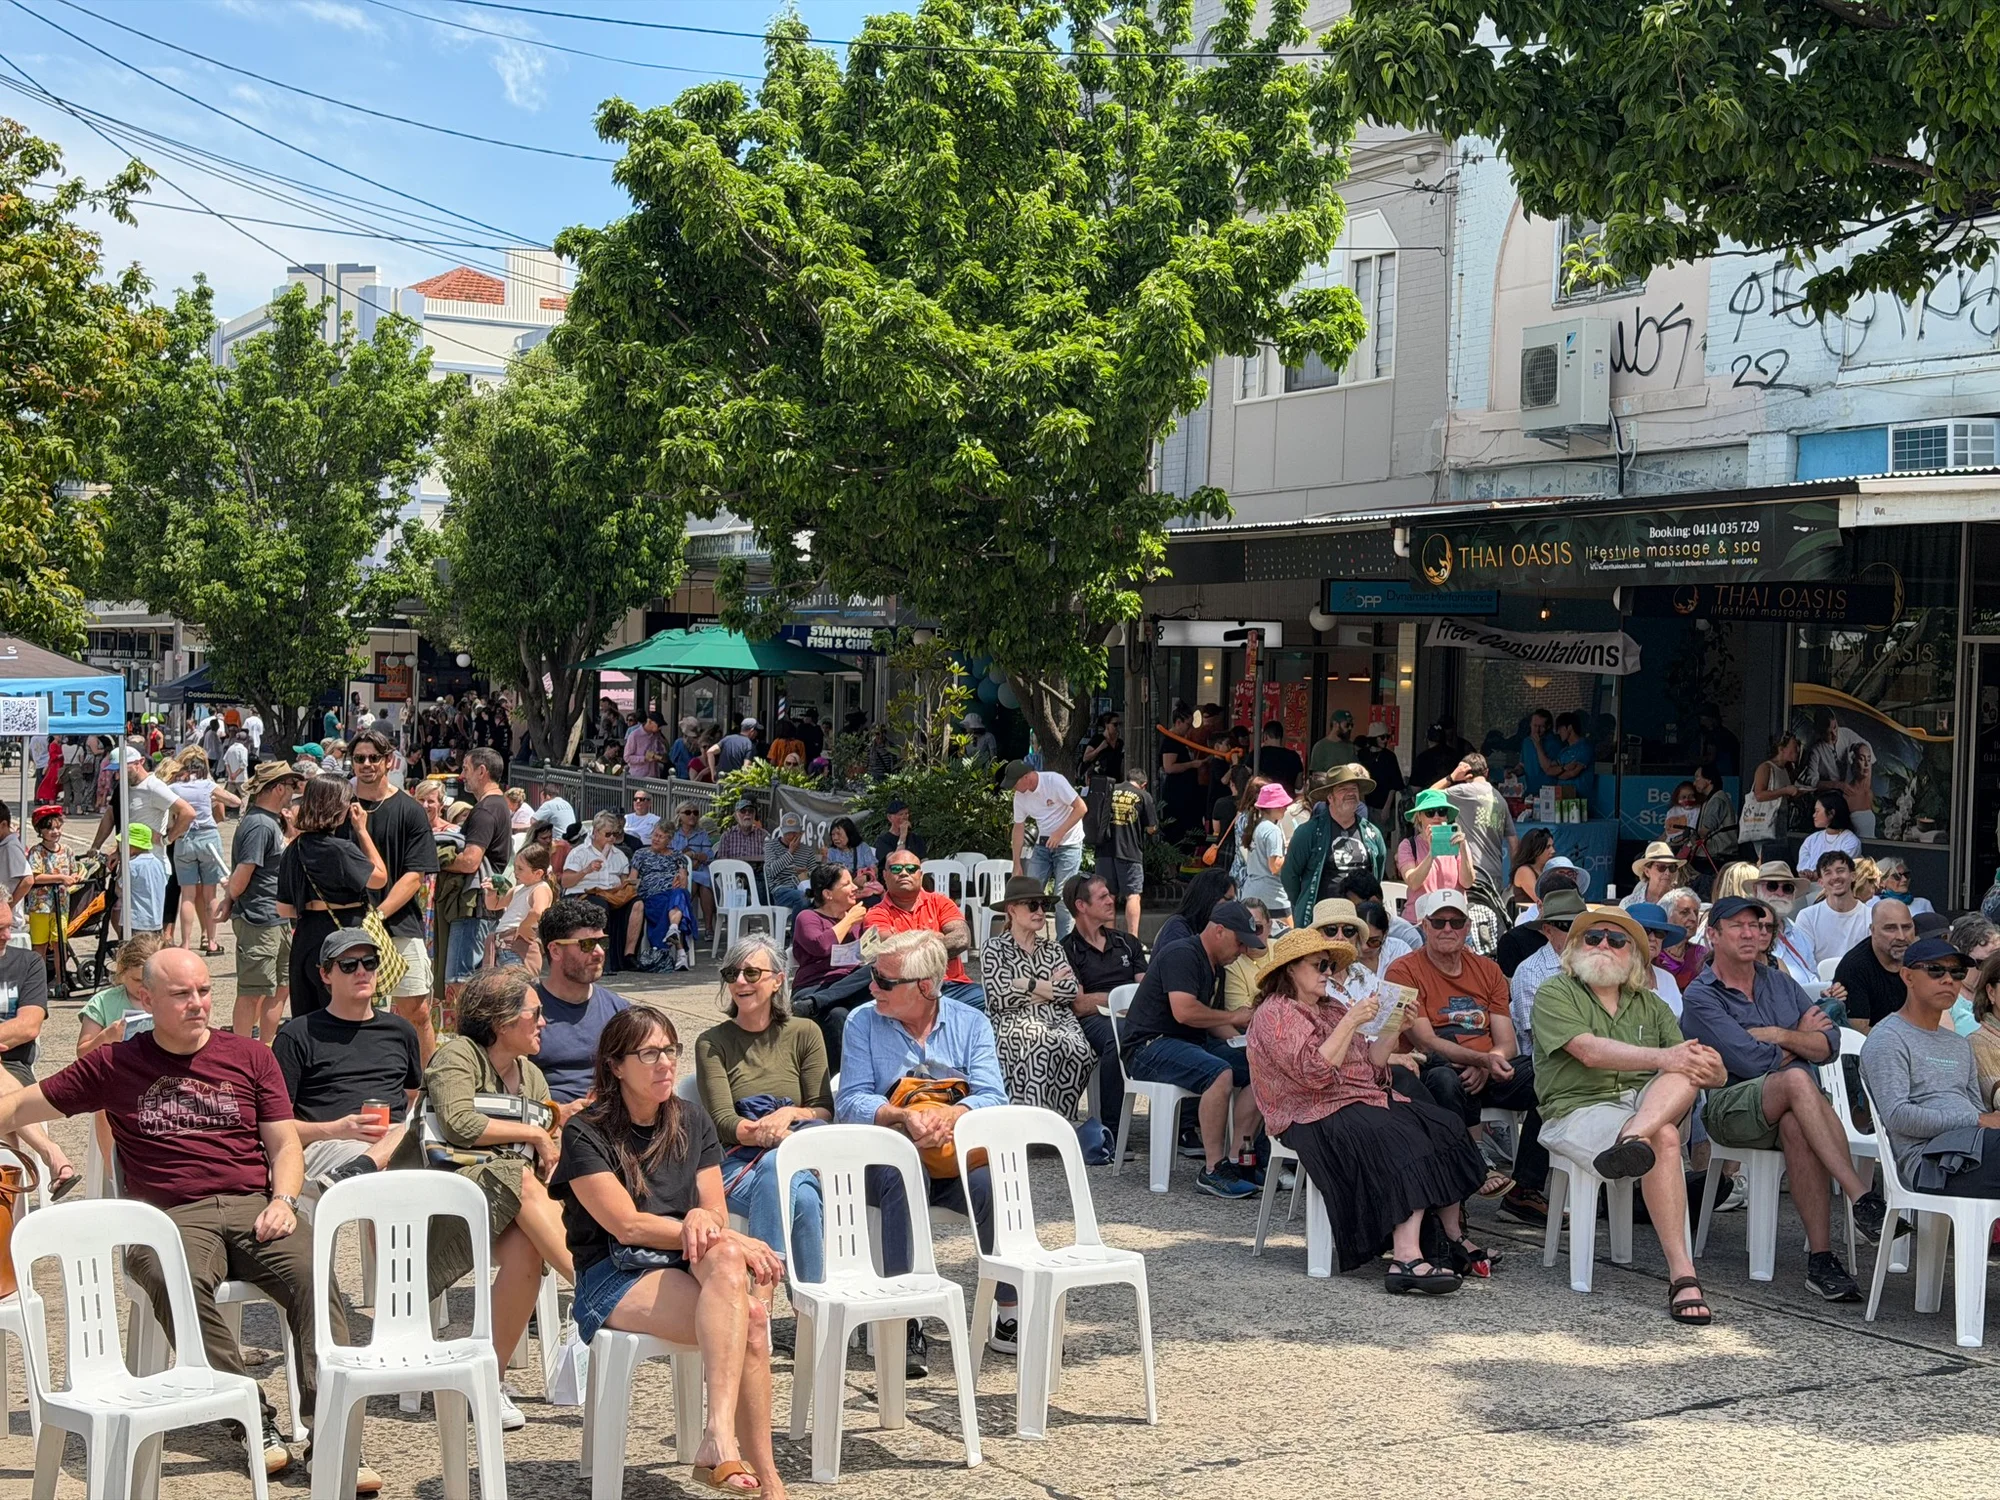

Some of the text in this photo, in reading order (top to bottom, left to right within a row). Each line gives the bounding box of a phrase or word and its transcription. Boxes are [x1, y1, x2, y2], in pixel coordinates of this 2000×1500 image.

[1731, 348, 1812, 396] 22
[1650, 521, 1760, 539] Booking: 0414 035 729
[1459, 541, 1573, 569] THAI OASIS
[1585, 540, 1761, 560] lifestyle massage & spa
[1714, 585, 1848, 610] THAI OASIS
[1711, 606, 1846, 620] lifestyle massage & spa
[810, 626, 874, 638] STANMORE
[1436, 617, 1478, 641] Free
[807, 637, 875, 650] FISH & CHIP
[1648, 788, 1671, 803] Be
[1442, 891, 1452, 902] P
